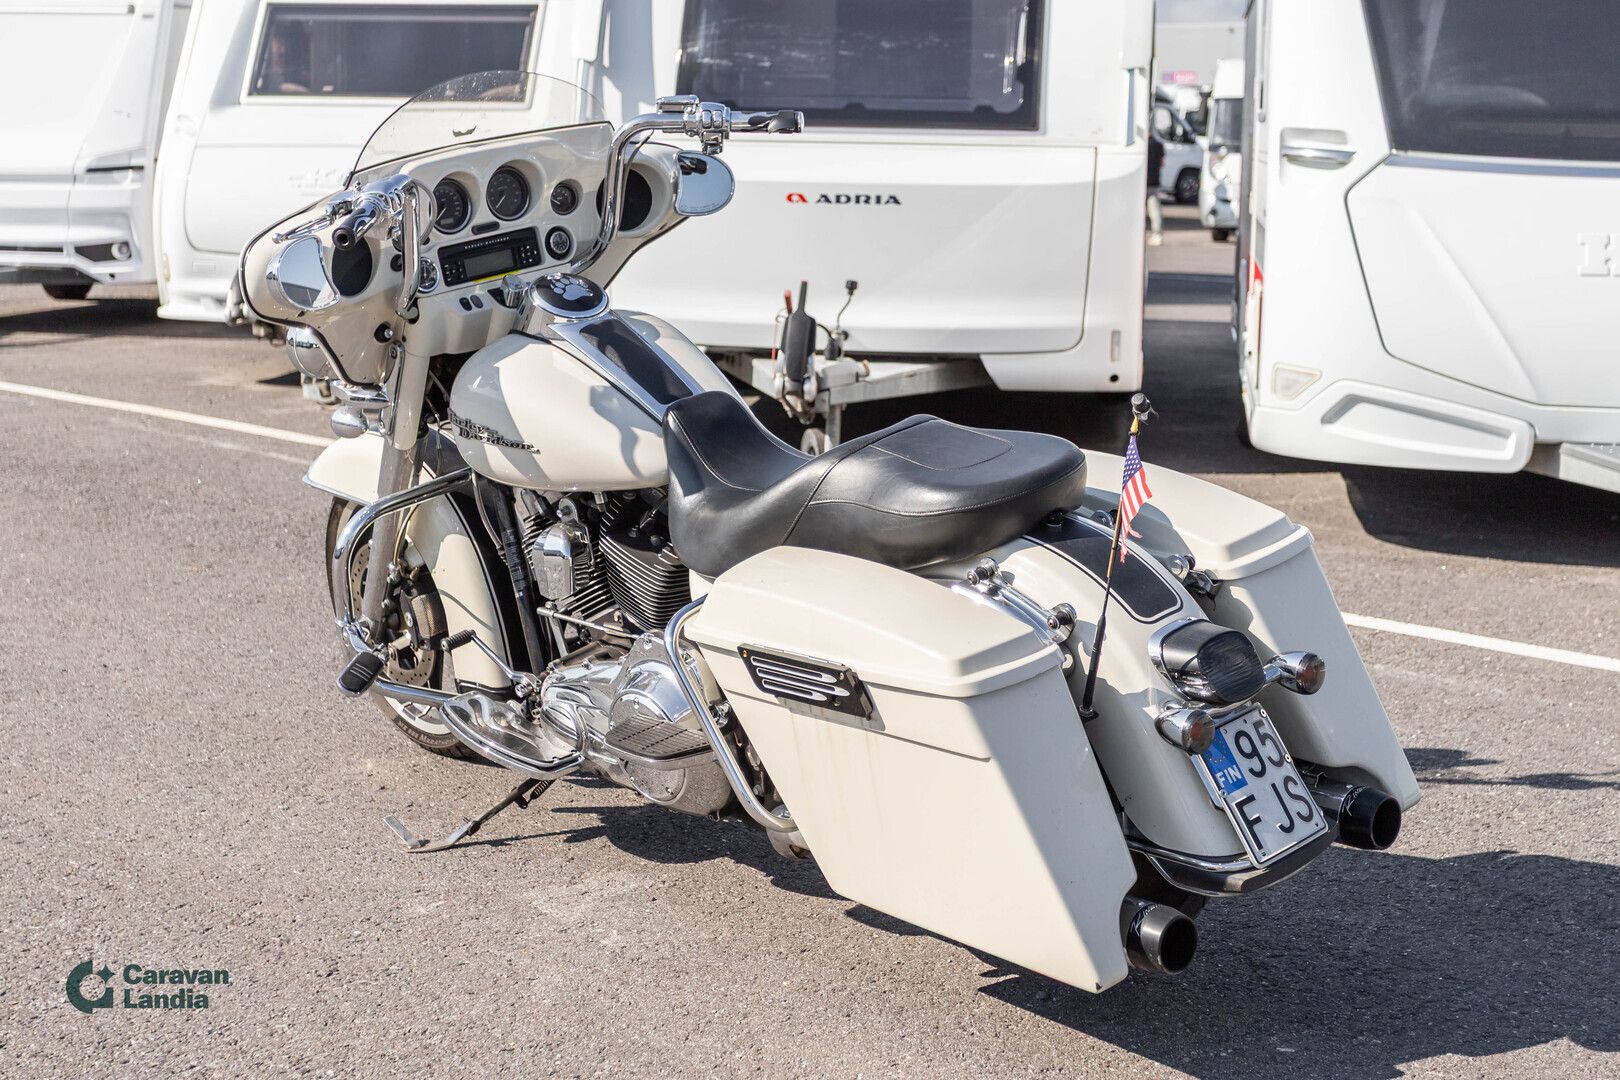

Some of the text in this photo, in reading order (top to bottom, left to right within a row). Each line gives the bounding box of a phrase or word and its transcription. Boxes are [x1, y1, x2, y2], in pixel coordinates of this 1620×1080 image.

[816, 193, 902, 205] ADRIA
[1234, 720, 1285, 778] 95
[1215, 764, 1242, 788] FIN
[1234, 775, 1314, 851] FJS
